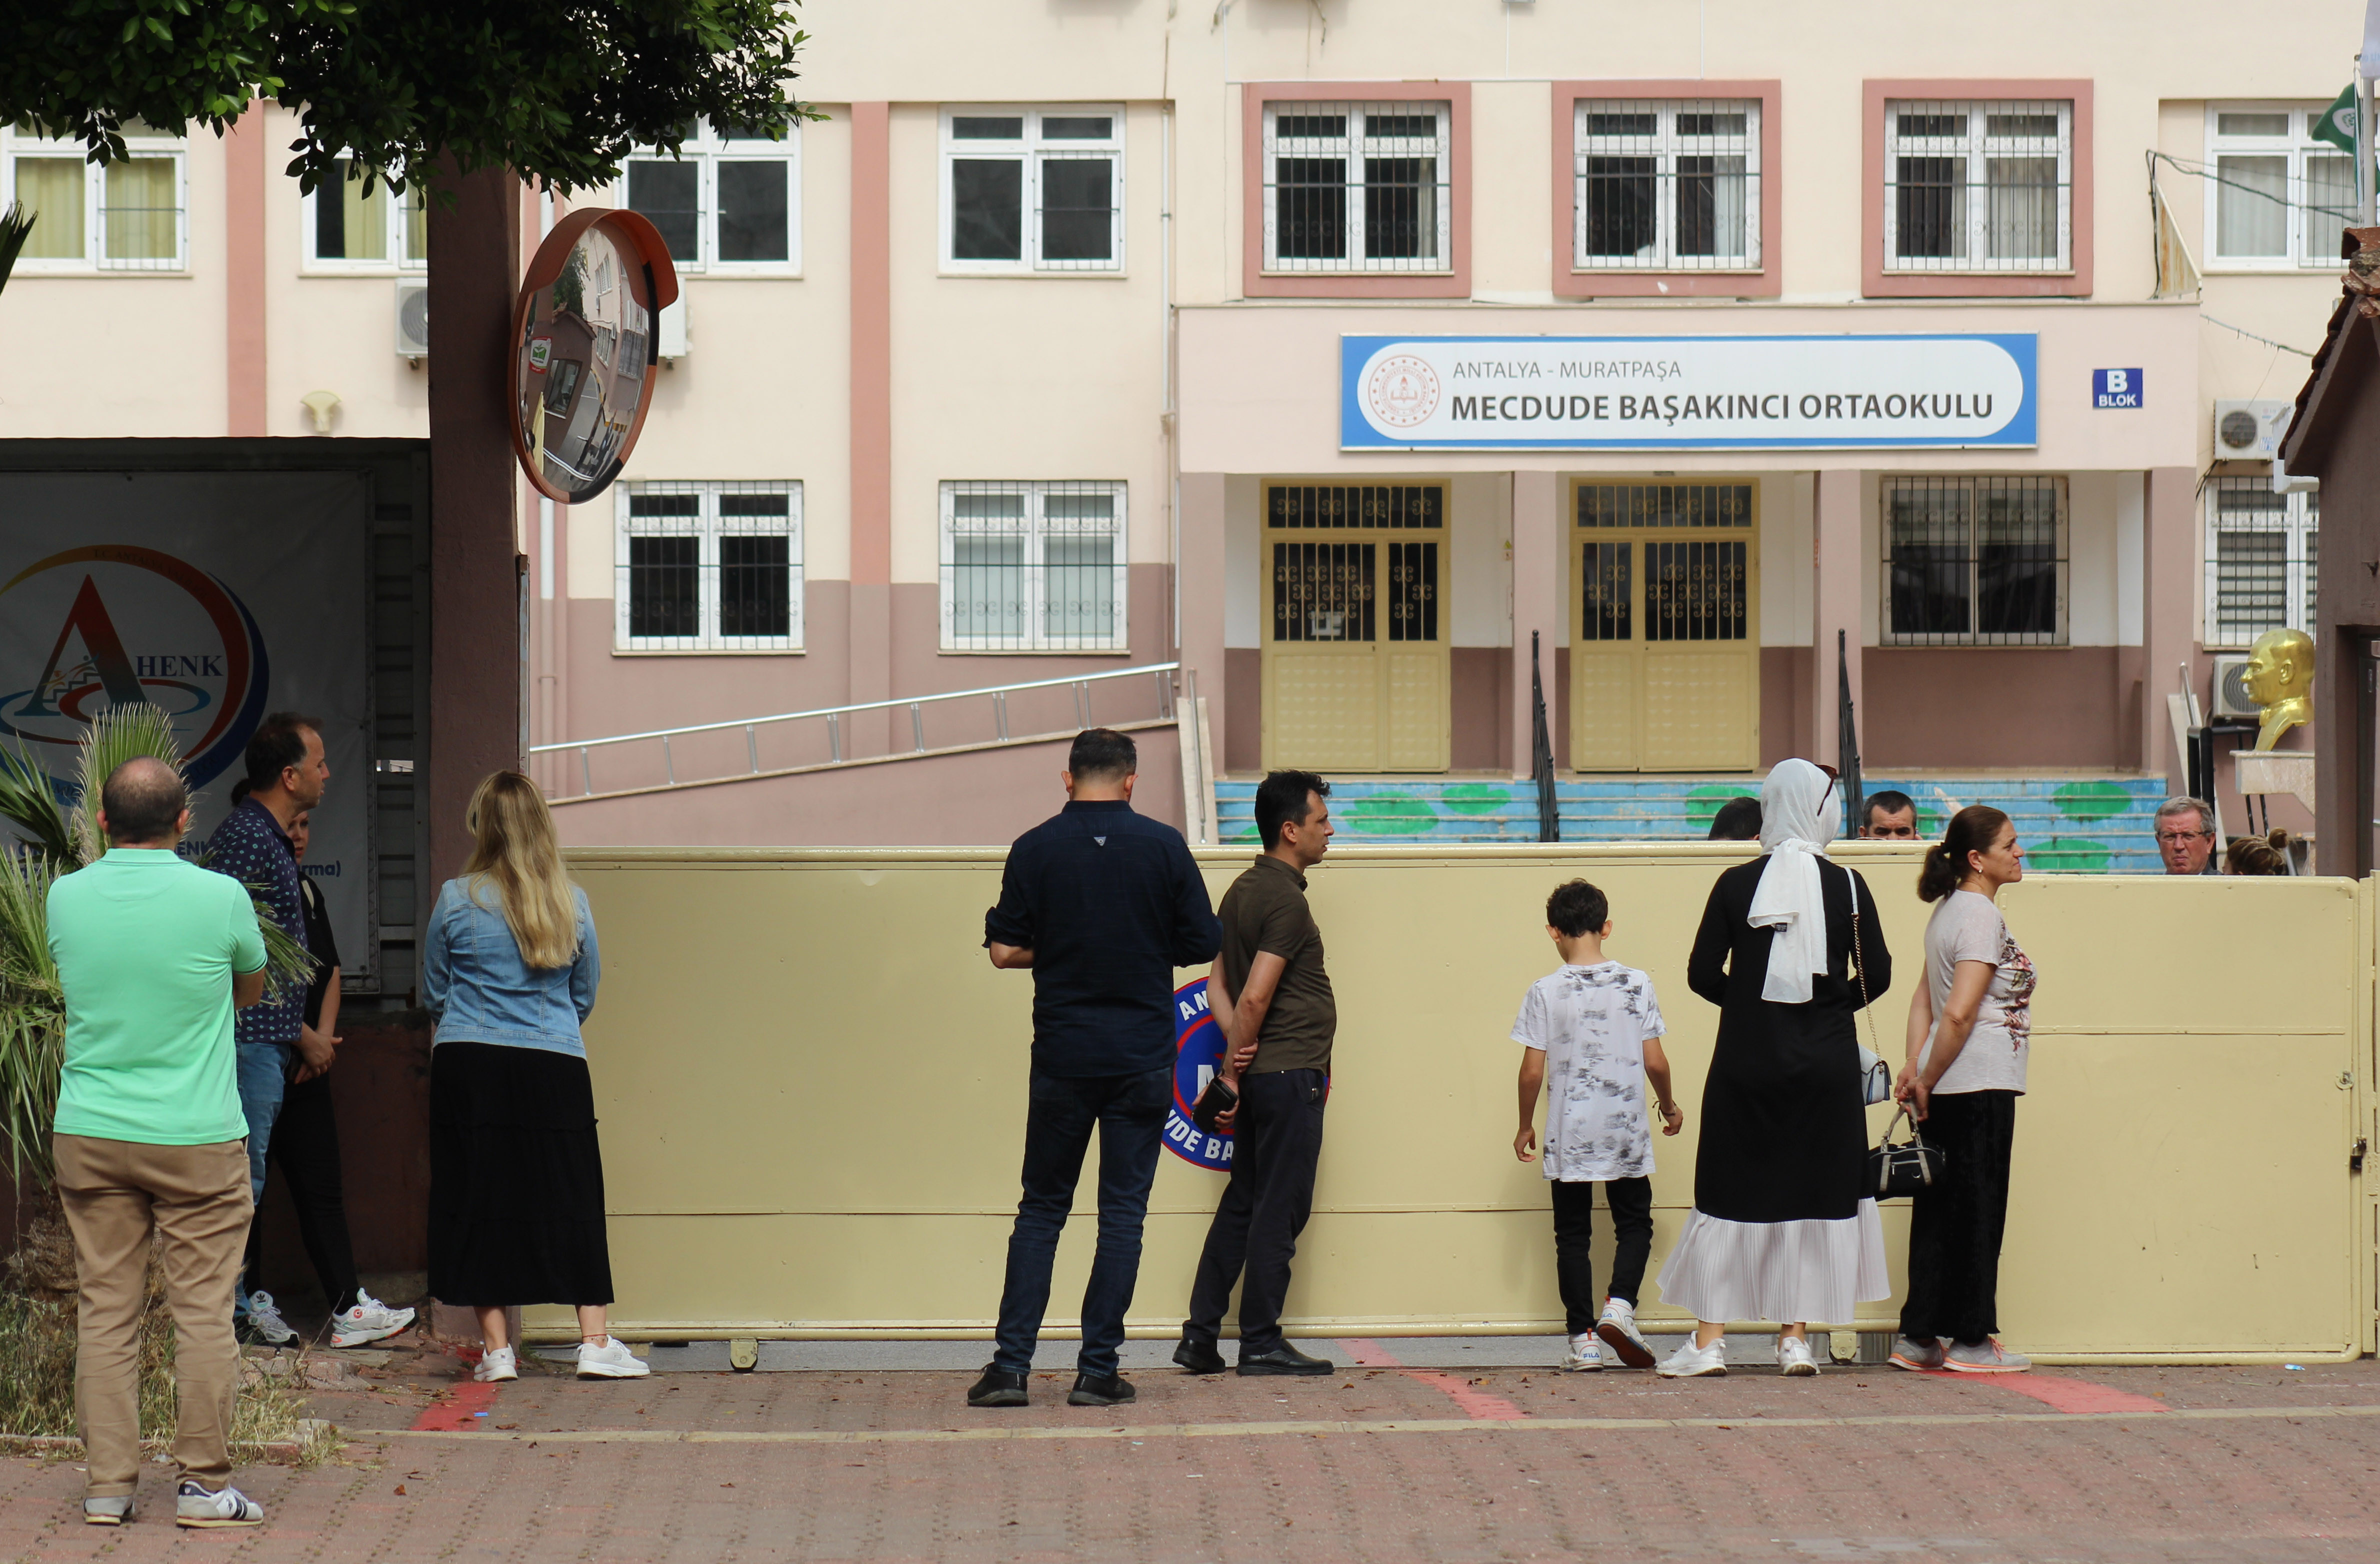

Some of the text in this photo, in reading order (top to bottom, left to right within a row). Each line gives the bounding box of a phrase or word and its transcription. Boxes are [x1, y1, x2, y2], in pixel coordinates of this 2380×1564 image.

[1452, 361, 1542, 378] ANTALYA
[1560, 360, 1682, 382] MURATPAŞA
[2107, 370, 2128, 393] B
[1451, 394, 1992, 426] MECDUDE BAŞAKINCI ORTAOKULU
[2098, 394, 2136, 407] BLOK
[302, 860, 341, 878] rma)
[1178, 990, 1210, 1021] AN
[1204, 1138, 1234, 1161] BA
